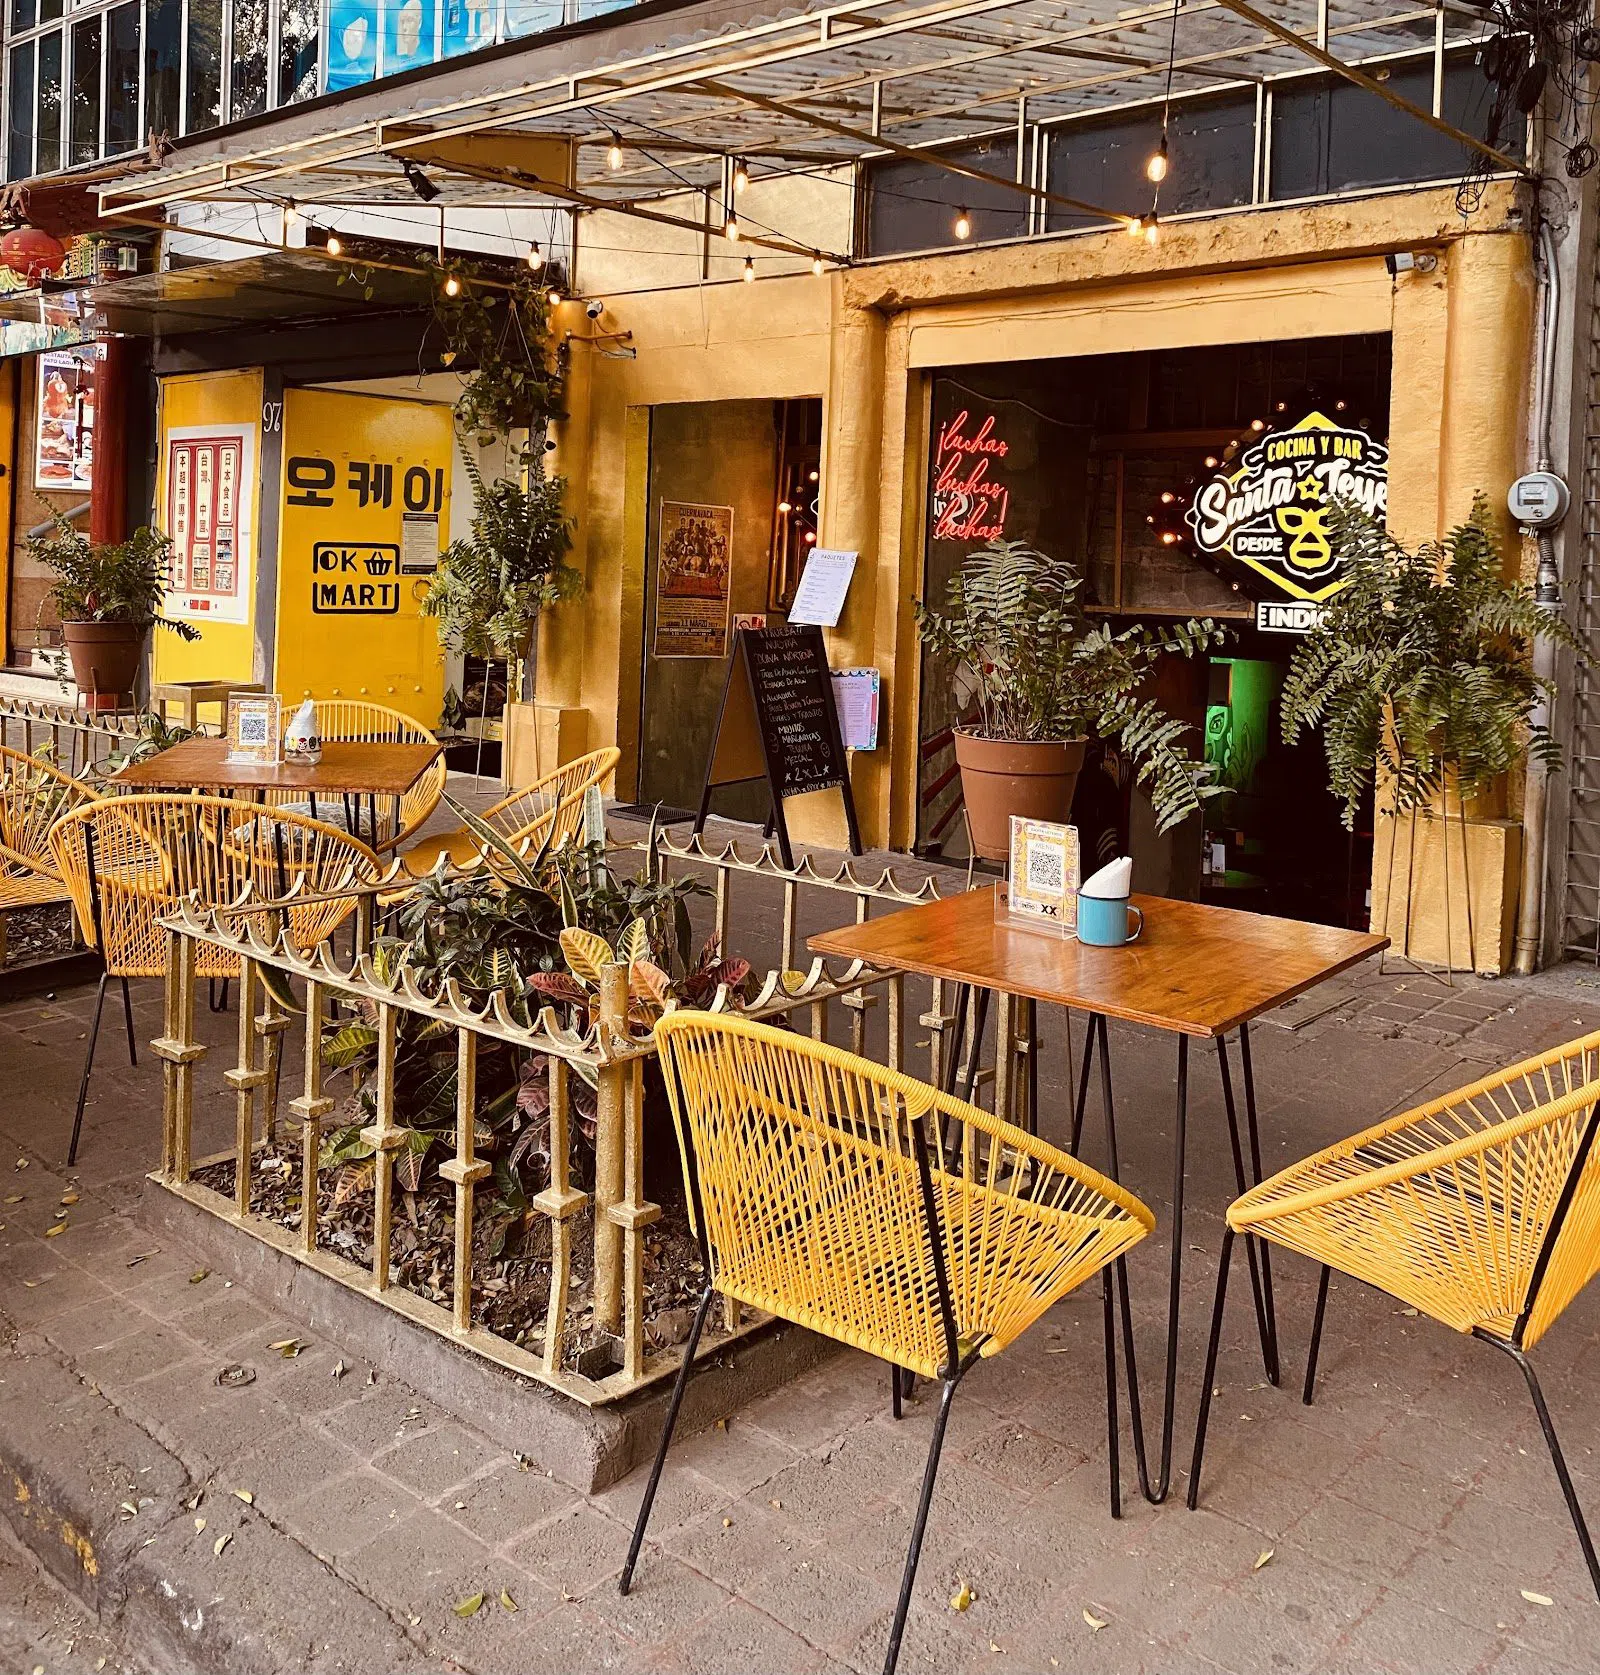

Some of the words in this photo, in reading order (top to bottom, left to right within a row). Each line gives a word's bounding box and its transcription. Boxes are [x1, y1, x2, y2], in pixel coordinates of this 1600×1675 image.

[263, 402, 282, 432] 97
[1267, 436, 1316, 462] COCINA
[1320, 436, 1329, 456] Y
[1333, 436, 1362, 460] BAR
[287, 456, 444, 513] 오케이
[936, 451, 1005, 498] luchas
[1200, 466, 1297, 545] Santa
[1313, 457, 1388, 518] Teye
[1237, 536, 1284, 552] DESDE
[319, 550, 358, 572] OK
[320, 584, 392, 606] MART
[1040, 903, 1057, 916] XX
